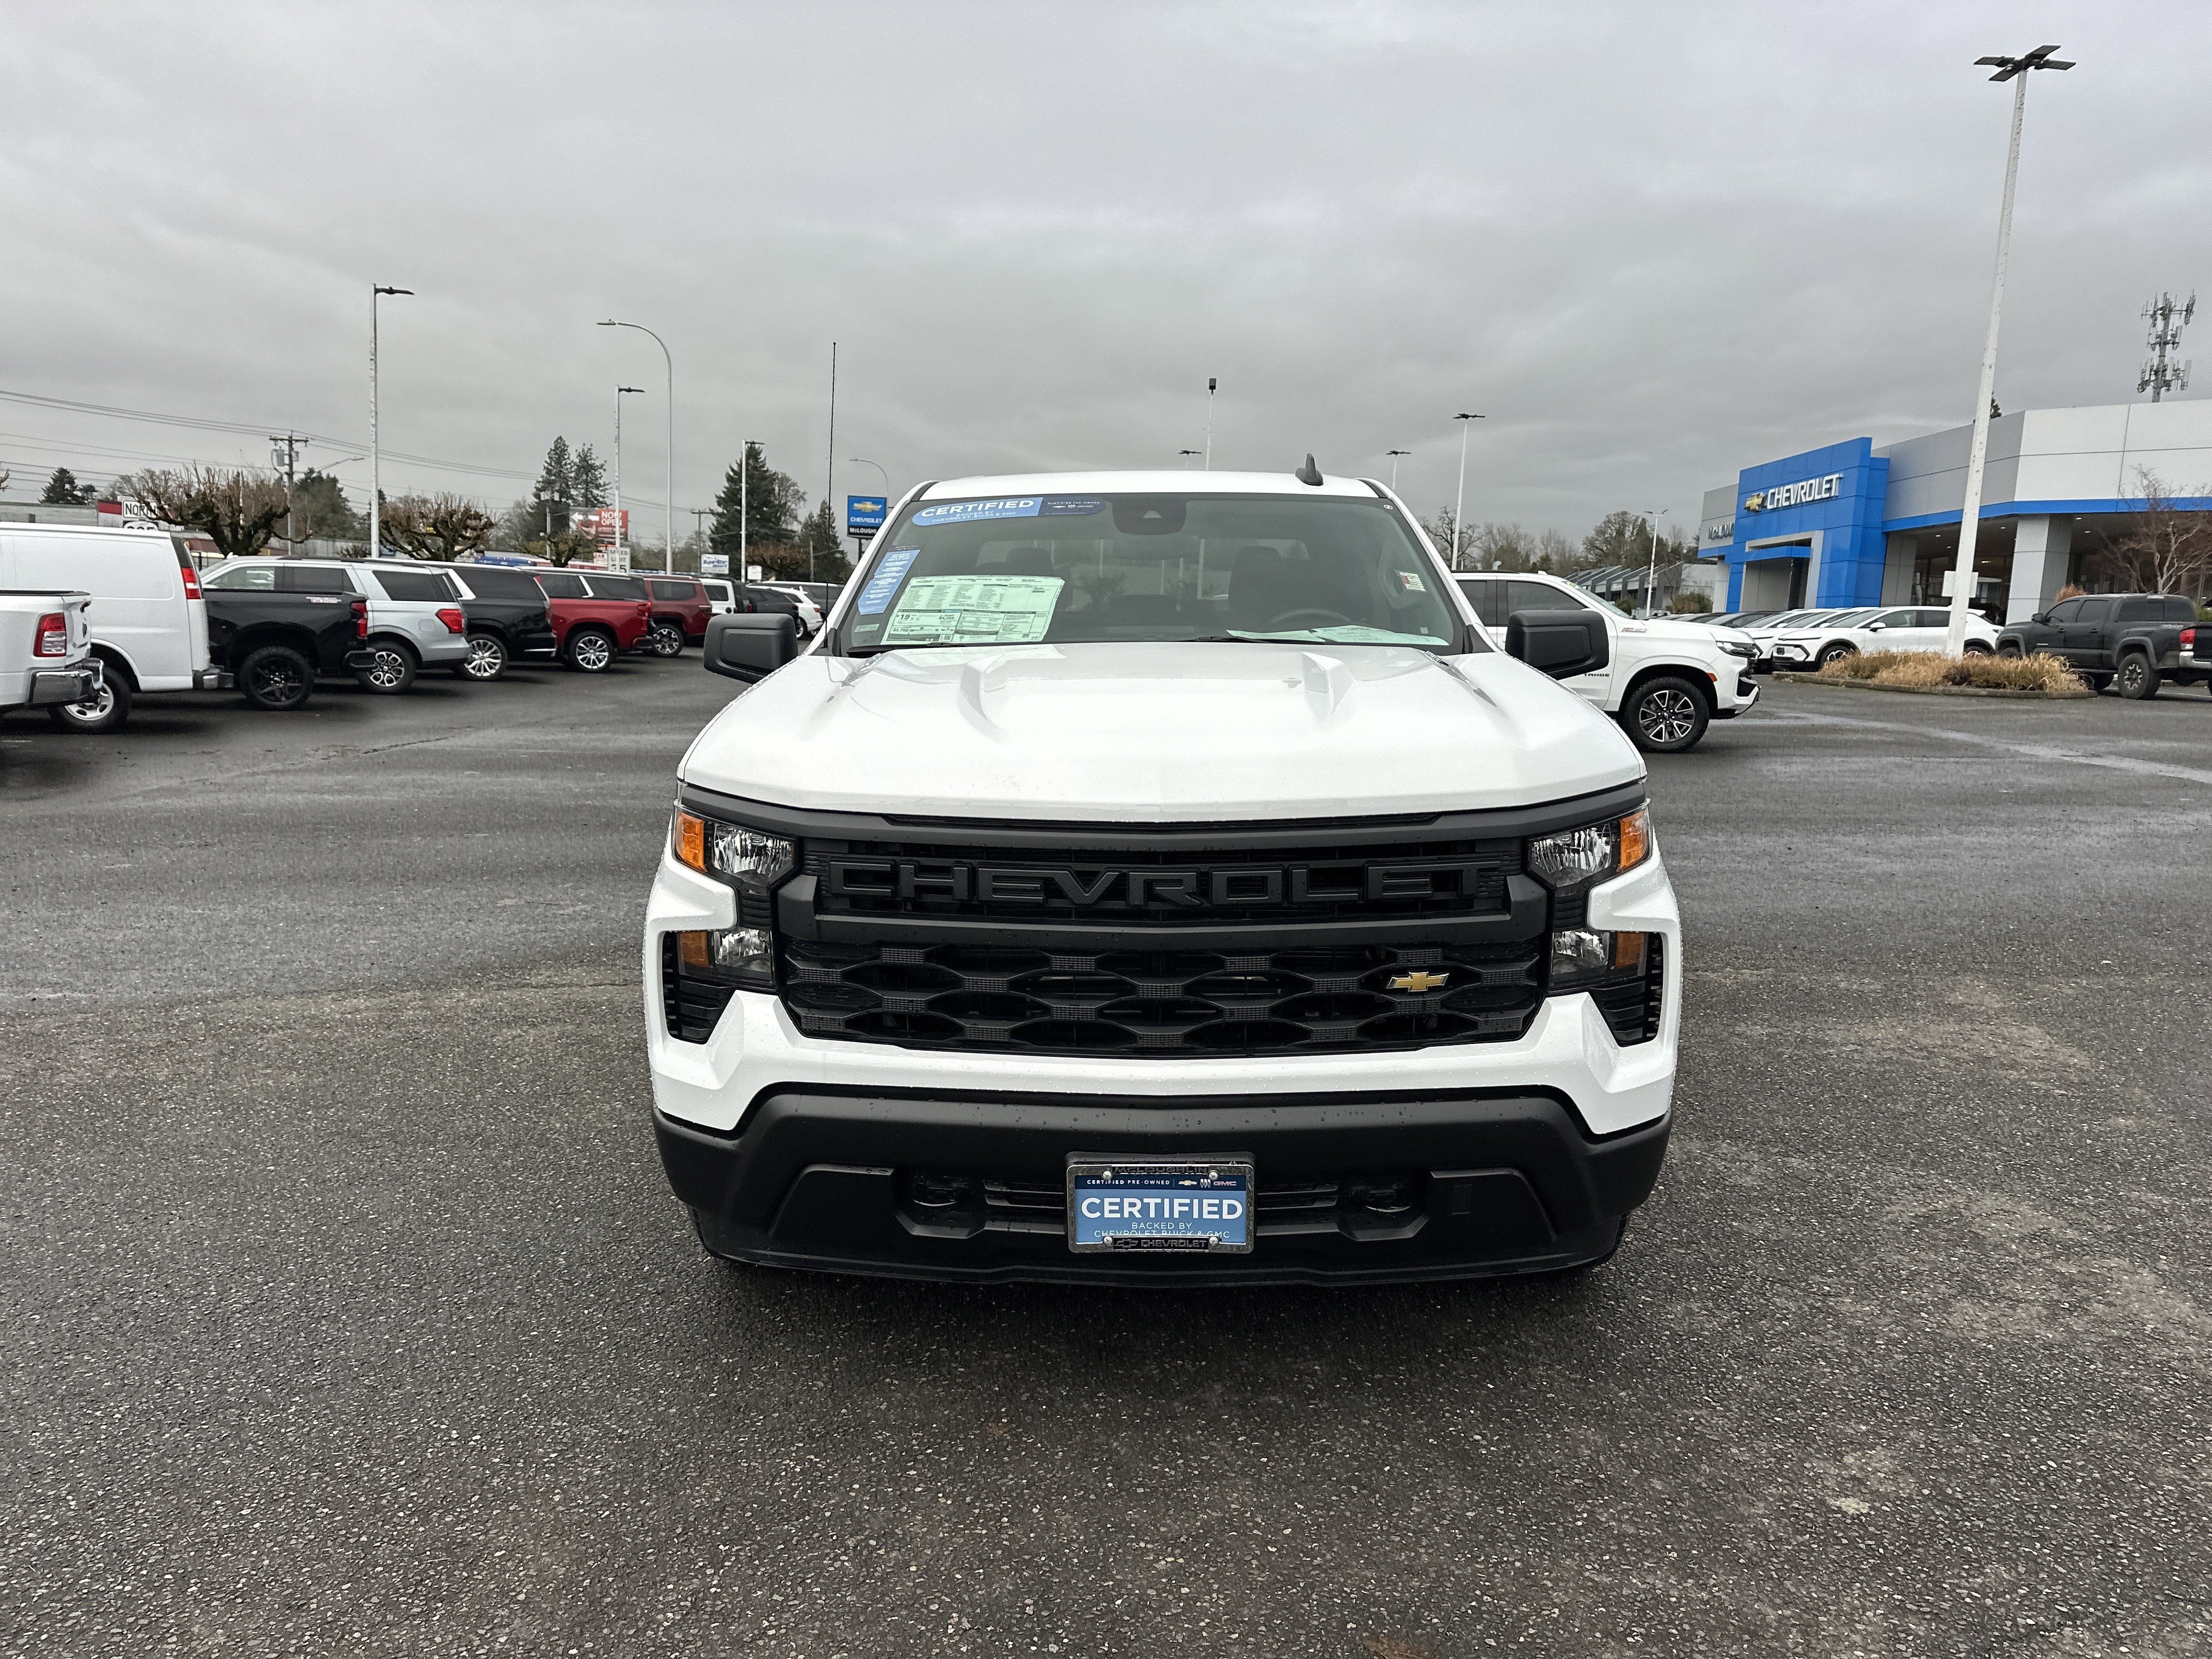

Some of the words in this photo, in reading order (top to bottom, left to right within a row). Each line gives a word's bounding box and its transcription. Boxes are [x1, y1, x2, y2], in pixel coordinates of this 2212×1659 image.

[1767, 473, 1839, 509] CHEVROLET
[921, 500, 1034, 517] CERTIFIED
[828, 859, 1502, 906] CHEVROLET
[1081, 1197, 1243, 1220] CERTIFIED
[1141, 1239, 1207, 1248] CHEVROLET
